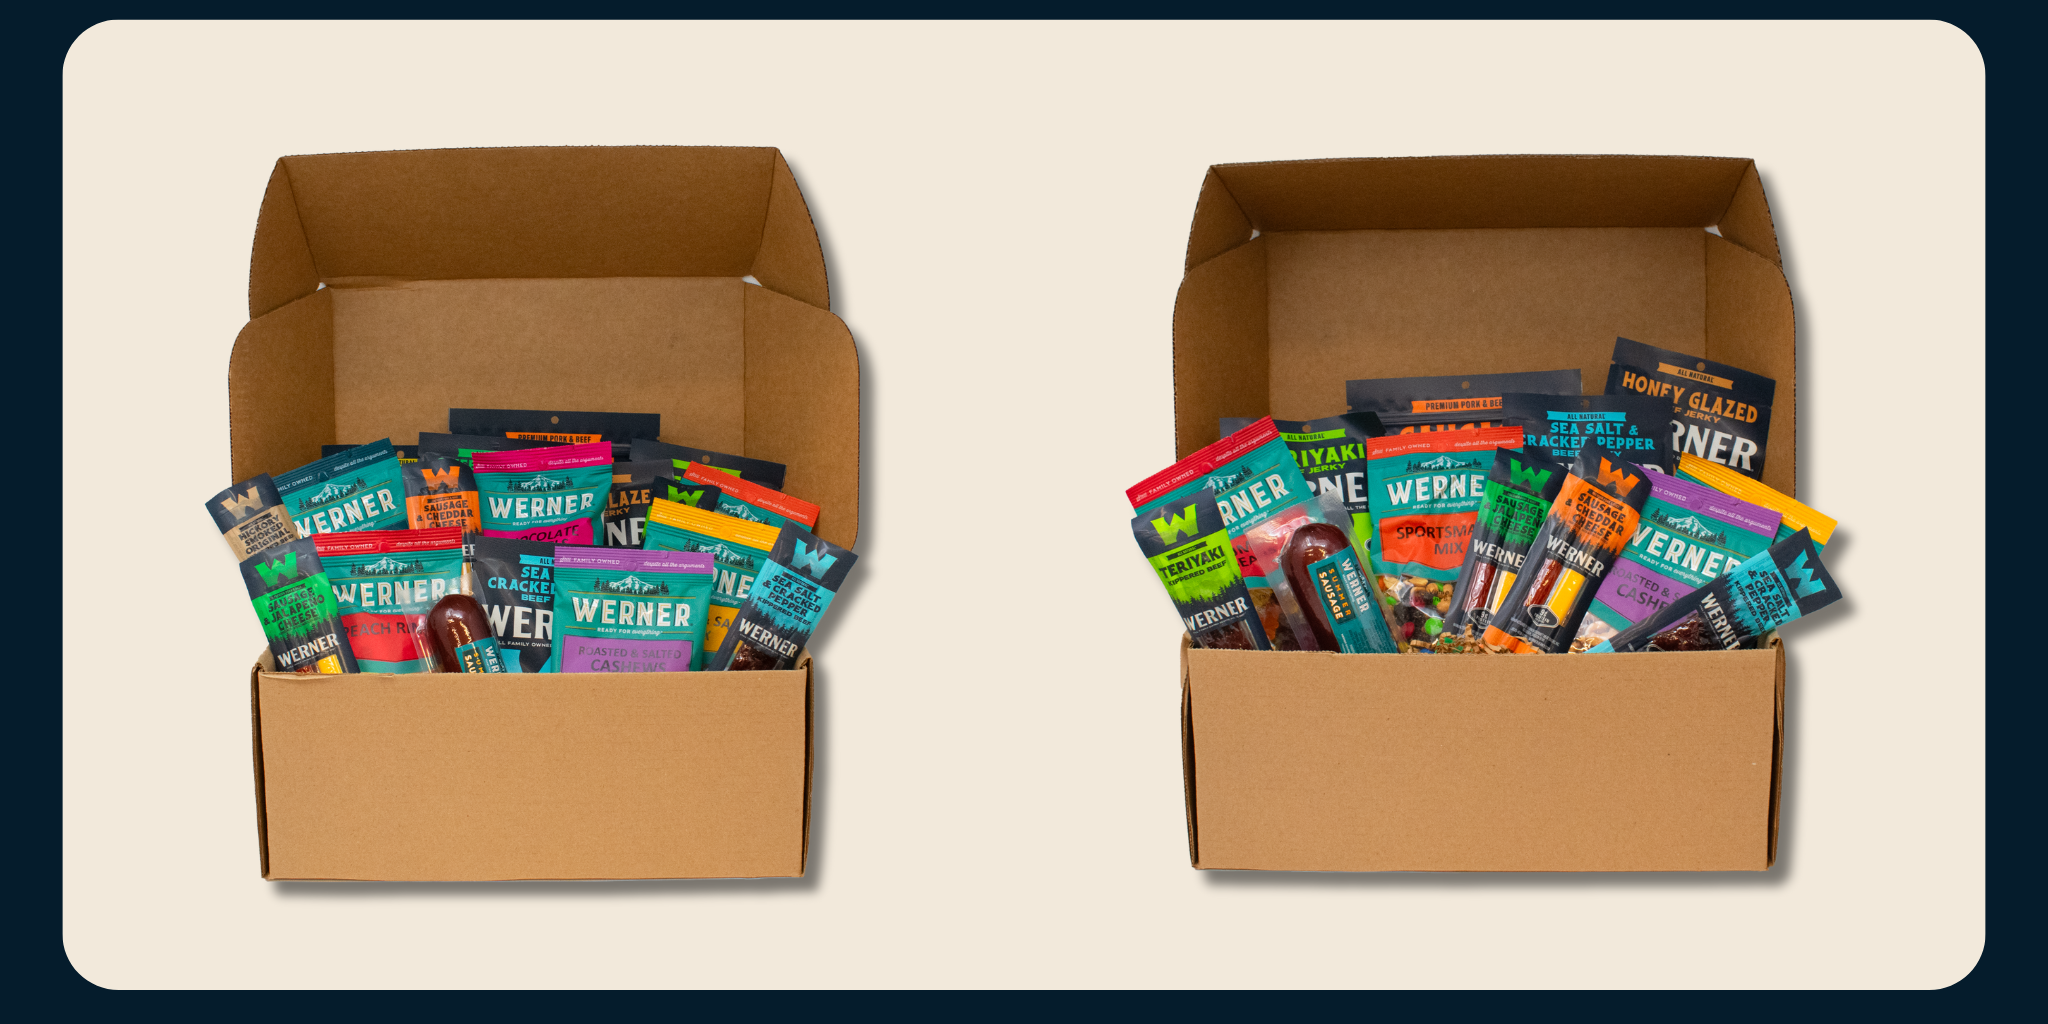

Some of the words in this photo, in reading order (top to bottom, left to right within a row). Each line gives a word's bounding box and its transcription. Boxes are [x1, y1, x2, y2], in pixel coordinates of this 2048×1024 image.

[1622, 371, 1686, 404] HONEY
[1689, 392, 1758, 423] GLAZED
[1585, 423, 1624, 435] SALT
[1684, 410, 1721, 424] JERKY
[1290, 443, 1366, 468] RIYAKI
[1597, 437, 1655, 450] PEPPER
[1670, 420, 1758, 471] RNER
[421, 466, 461, 491] W
[1308, 462, 1346, 475] JERKY
[1510, 458, 1553, 493] W
[1596, 456, 1640, 498] W
[221, 486, 264, 520] W
[608, 489, 652, 508] LAZE
[668, 484, 706, 508] W
[1217, 474, 1291, 527] RNER
[1387, 474, 1485, 505] WERNE
[424, 500, 469, 513] SAUSAGE
[426, 509, 474, 521] CHEDDAR
[487, 493, 595, 519] WERNER
[1496, 495, 1544, 519] SAUSAGE
[1578, 493, 1626, 523] SAUSAGE
[238, 514, 280, 541] HICKORY
[1150, 503, 1199, 546] W
[1396, 524, 1475, 539] SPORTSMA
[1493, 516, 1535, 537] CHEESE
[1572, 514, 1612, 541] CHEESE
[1576, 503, 1624, 537] CHEDDAR
[244, 522, 284, 547] SMOKED
[245, 528, 291, 555] ORIGINAL
[791, 538, 838, 580] W
[1159, 545, 1226, 579] TERIYAKI
[1473, 539, 1526, 568] WERNE
[1547, 534, 1605, 577] WERNER
[254, 551, 299, 587] W
[521, 566, 551, 580] SEA
[1168, 569, 1205, 586] KIPPERED
[1784, 548, 1827, 599] W
[332, 578, 447, 607] WERNER
[795, 586, 822, 603] SALT
[1319, 571, 1344, 620] SAUSAGE
[1328, 568, 1352, 616] SUMMER
[1341, 558, 1370, 613] WERNER
[1734, 580, 1757, 617] KIPPERED
[268, 587, 315, 612] SAUSAGE
[572, 597, 691, 627] WERNER
[757, 596, 793, 617] KIPPERED
[768, 592, 808, 617] PEPPER
[773, 586, 822, 613] CRACKED
[1744, 583, 1770, 624] PEPPER
[1754, 579, 1783, 626] CRACKED
[1772, 593, 1791, 618] SALT
[278, 608, 318, 632] CHEESE
[482, 604, 554, 640] WER
[1183, 596, 1249, 631] WERNER
[345, 622, 391, 637] PEACH
[738, 618, 798, 658] WERNER
[278, 633, 340, 667] WERNER
[579, 646, 628, 658] ROASTED
[591, 659, 667, 673] CASHEWS
